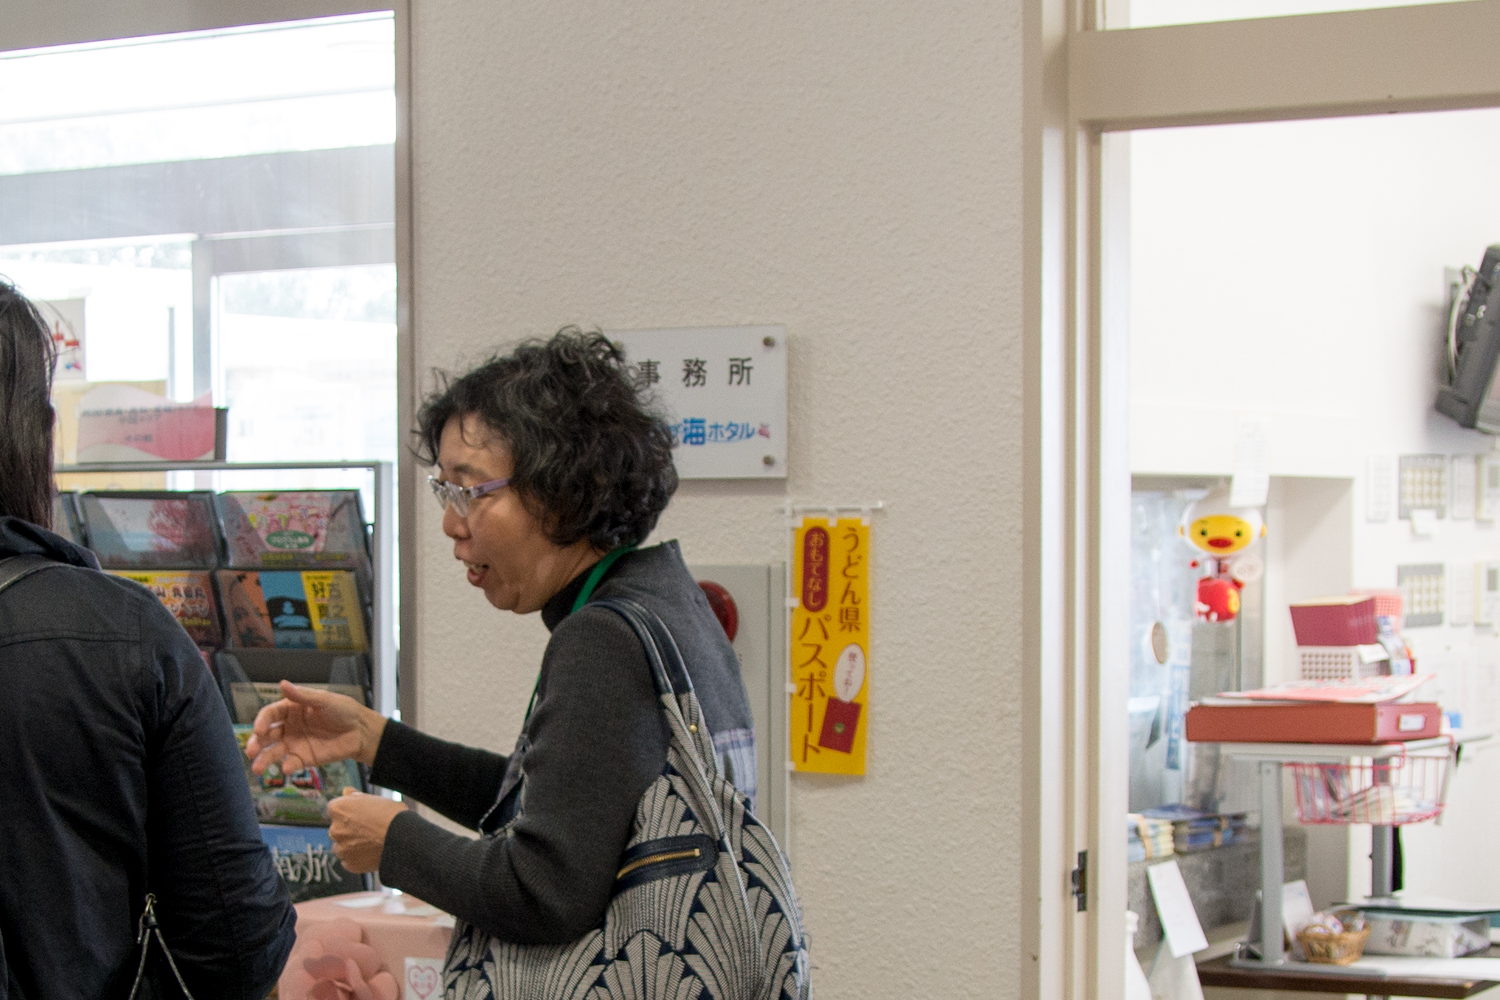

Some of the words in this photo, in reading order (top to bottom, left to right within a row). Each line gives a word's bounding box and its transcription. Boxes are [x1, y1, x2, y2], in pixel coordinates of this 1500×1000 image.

[637, 356, 754, 388] 事務所
[807, 532, 825, 606] おもてなし
[840, 526, 863, 633] うどん県
[798, 615, 832, 763] パスポート
